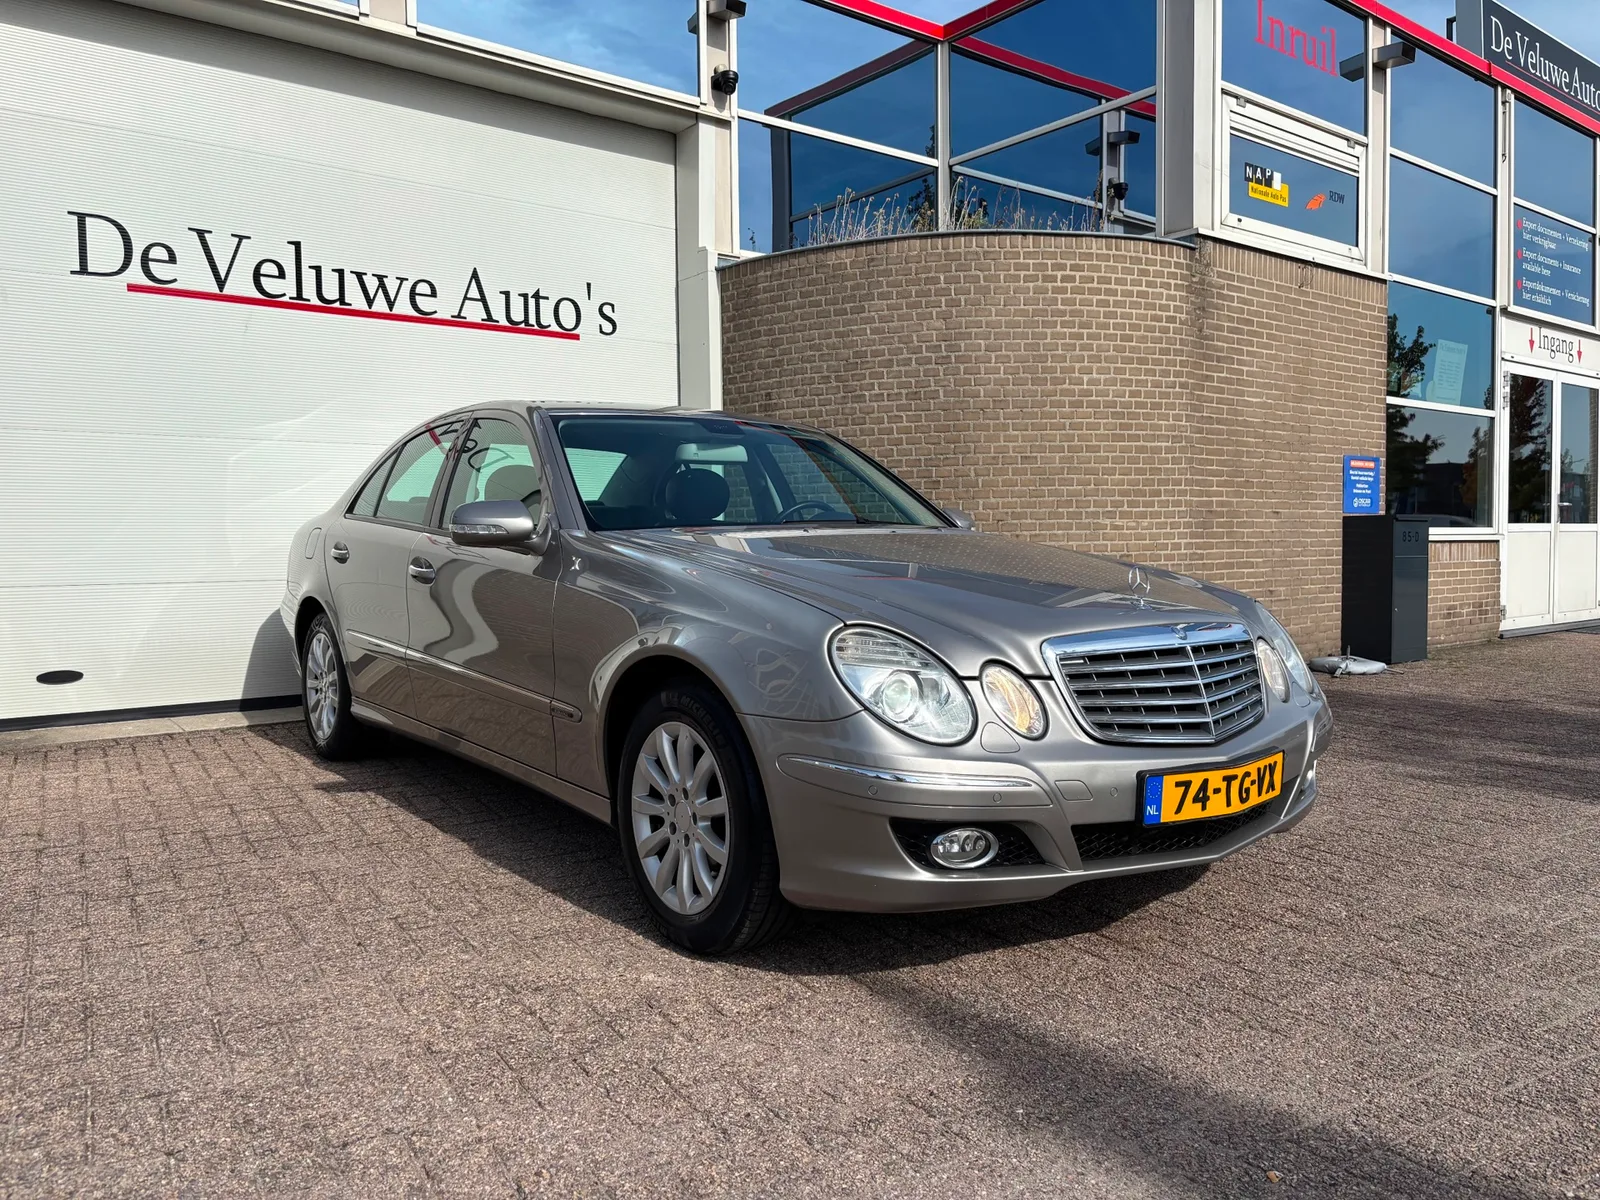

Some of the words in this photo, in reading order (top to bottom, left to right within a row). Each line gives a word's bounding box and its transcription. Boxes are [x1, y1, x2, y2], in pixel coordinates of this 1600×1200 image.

[1254, 0, 1338, 77] Inruil
[1490, 15, 1513, 60] De
[1515, 30, 1569, 93] Veluwe
[1245, 165, 1272, 180] NAP
[1250, 185, 1270, 198] Nationale
[1270, 190, 1279, 201] Auto
[1279, 194, 1287, 203] Pas
[1328, 190, 1345, 205] RDW
[1522, 217, 1537, 232] Export
[1537, 222, 1562, 240] documenten
[1522, 229, 1532, 242] hier
[1522, 247, 1537, 261] Export
[1537, 252, 1560, 268] documents
[1562, 260, 1582, 275] Insurance
[1522, 261, 1541, 274] available
[1541, 265, 1551, 277] here
[66, 210, 179, 286] De
[188, 226, 439, 317] Veluwe
[450, 266, 618, 337] Auto's
[1522, 288, 1532, 300] hier
[1538, 326, 1574, 364] Ingang
[1173, 760, 1278, 815] 74-TG-VX
[1146, 805, 1159, 816] NL
